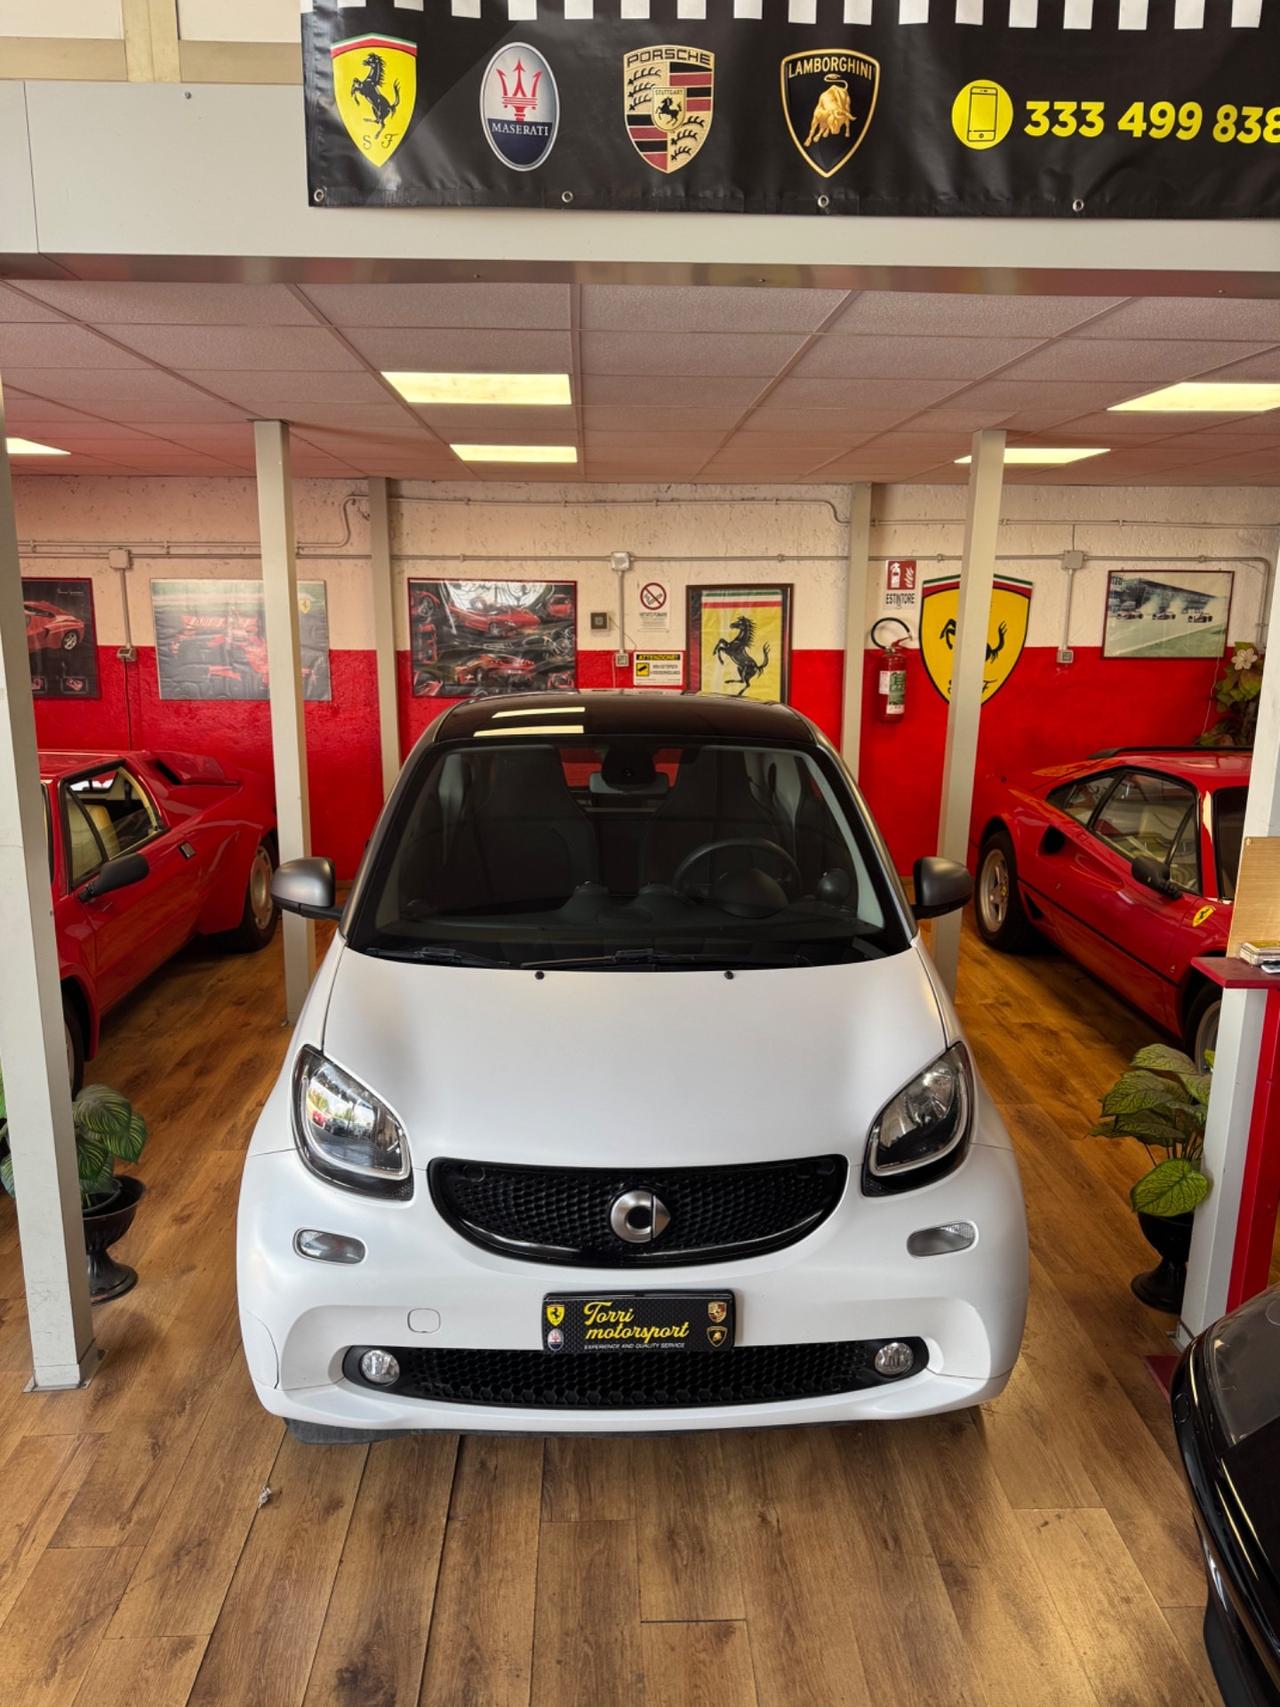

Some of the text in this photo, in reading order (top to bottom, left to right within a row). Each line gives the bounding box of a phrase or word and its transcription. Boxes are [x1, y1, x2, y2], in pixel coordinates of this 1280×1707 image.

[626, 48, 711, 68] PORSCHE
[788, 56, 872, 80] LAMBORGHINI
[491, 122, 549, 136] MASERATI
[1023, 101, 1105, 138] 333
[1117, 101, 1203, 141] 499
[583, 1301, 635, 1326] Torri
[585, 1321, 690, 1344] motorsport
